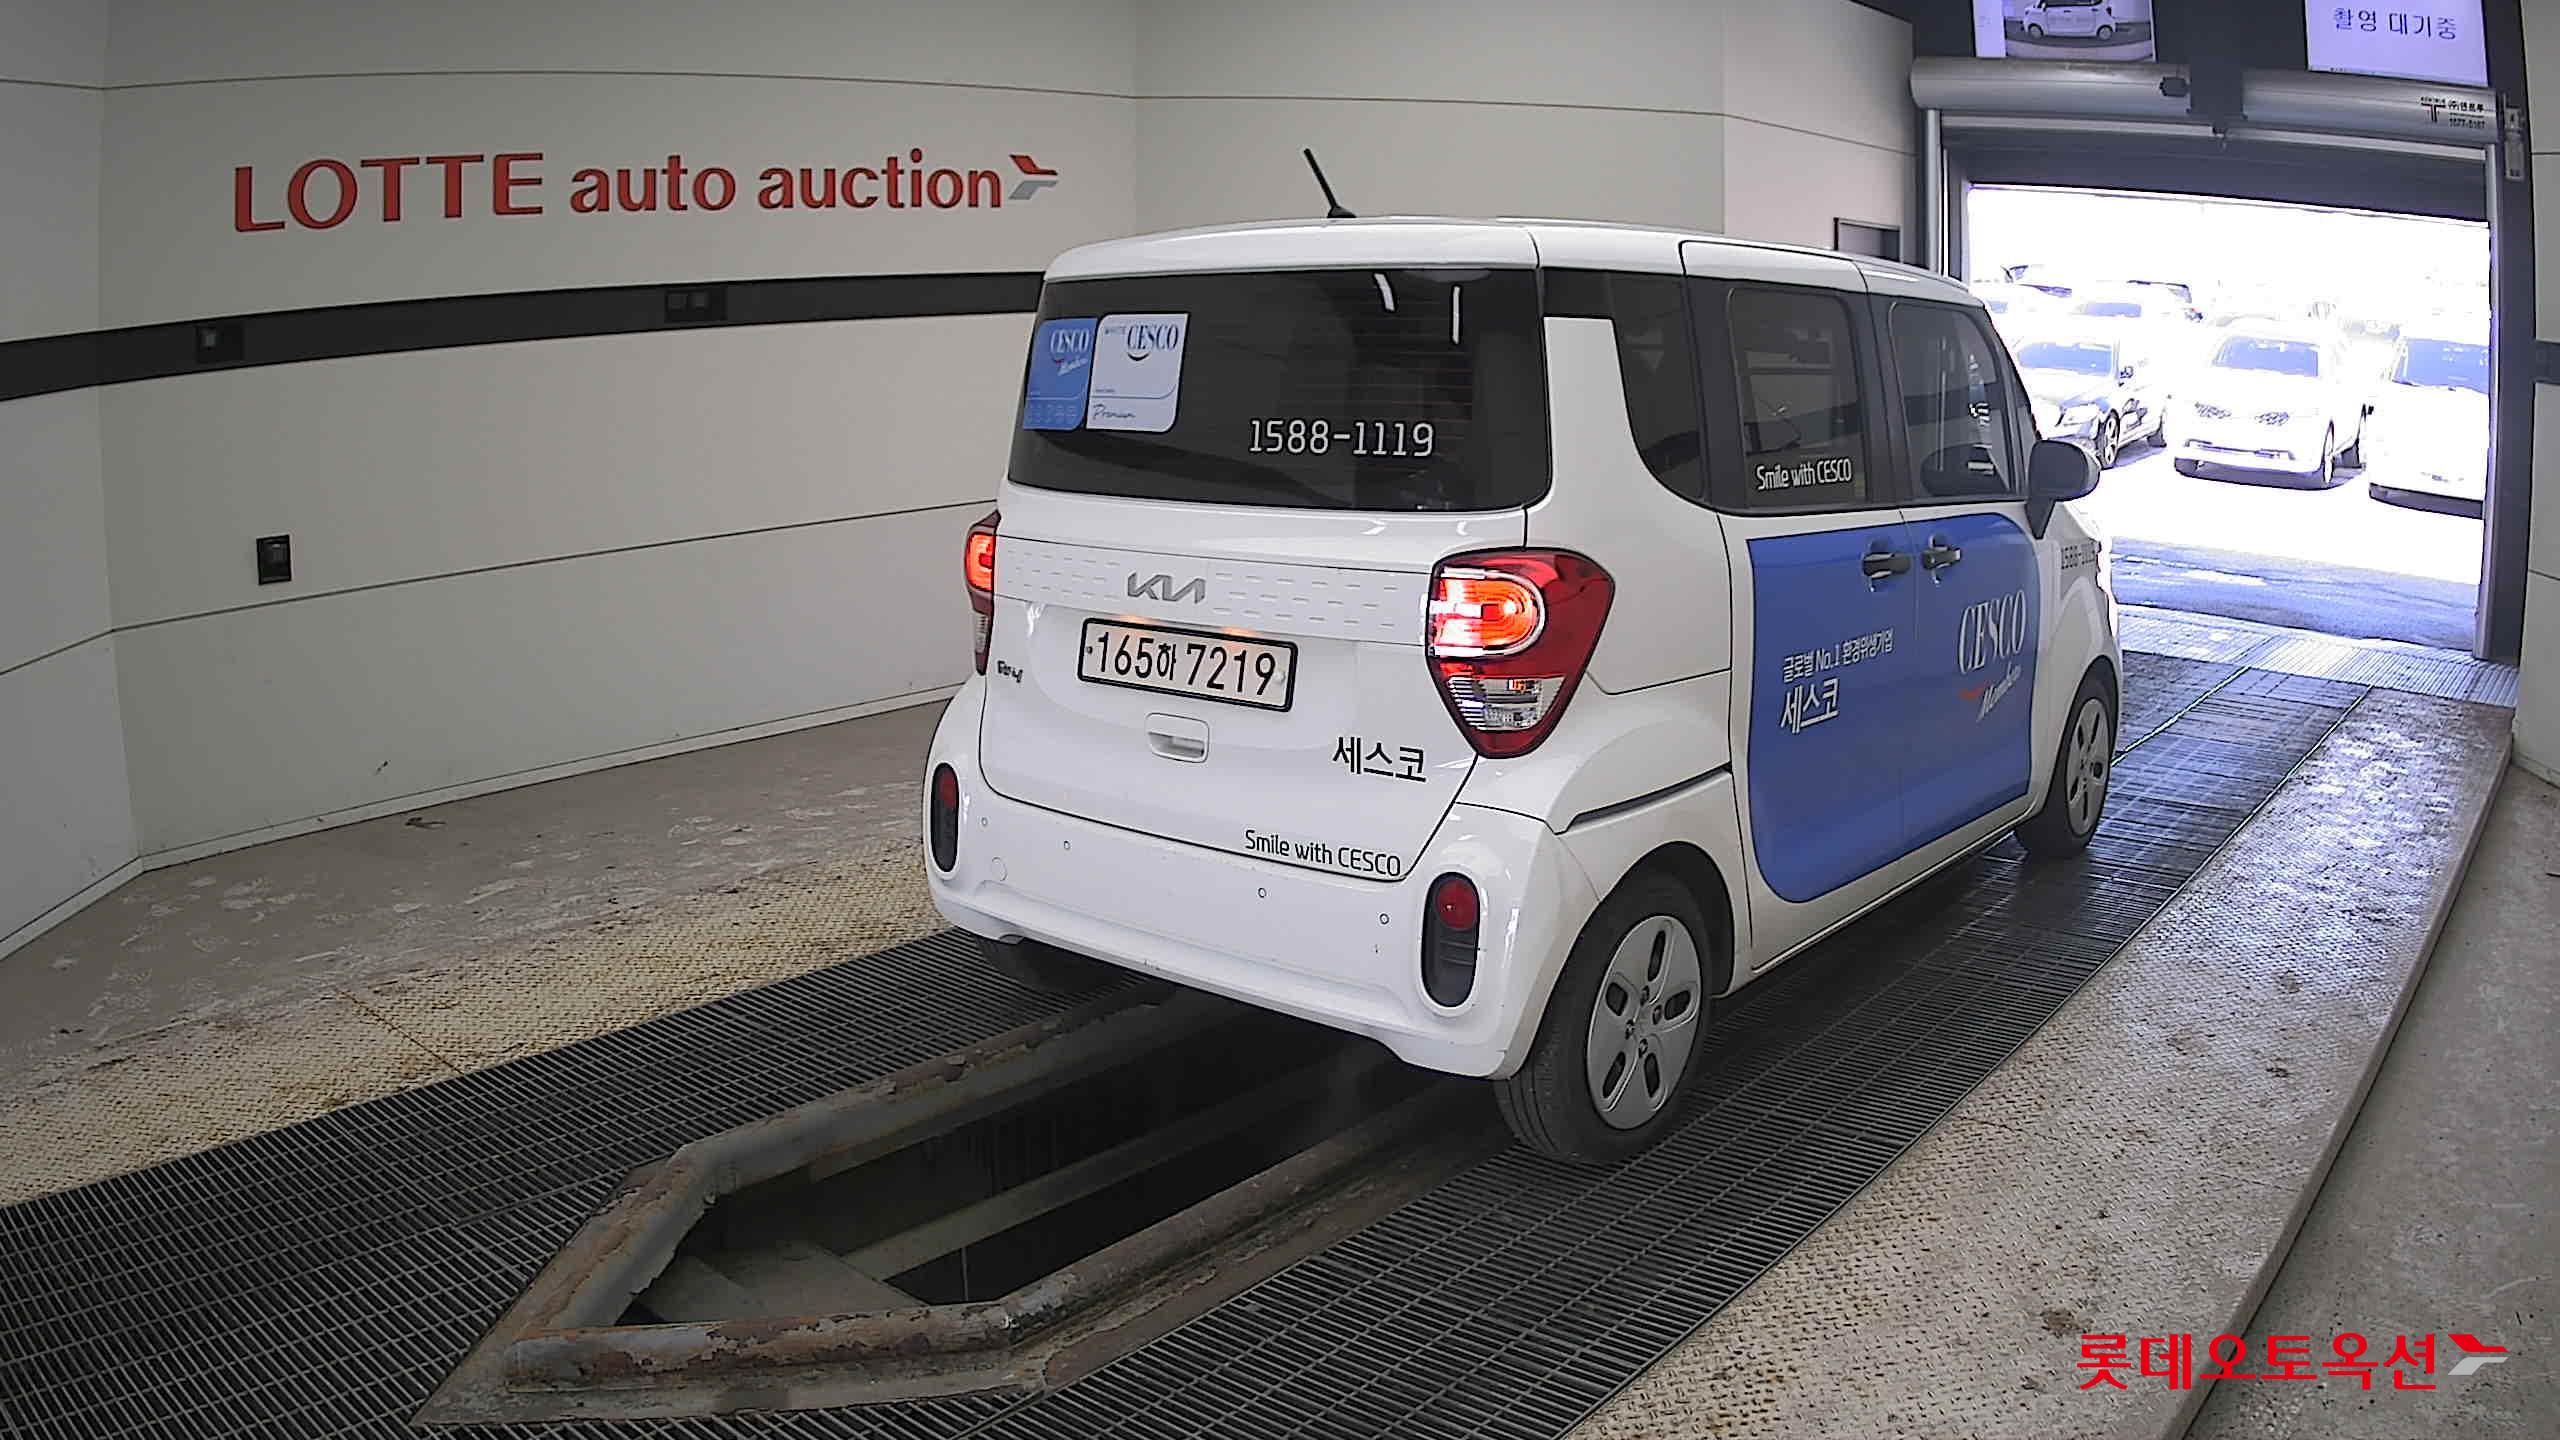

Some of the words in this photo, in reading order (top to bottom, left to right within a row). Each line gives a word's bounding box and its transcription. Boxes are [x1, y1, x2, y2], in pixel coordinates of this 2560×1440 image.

[2389, 13, 2457, 40] 대기중
[234, 152, 544, 233] LOTTE
[570, 154, 736, 213] auto
[759, 148, 1002, 210] auction
[1050, 328, 1090, 353] CESCO
[1127, 323, 1179, 351] CESCO
[1249, 419, 1435, 457] 1588-1119
[1757, 464, 1789, 490] Smile
[1791, 461, 1816, 487] with
[1817, 458, 1852, 483] CESCO
[1959, 589, 2026, 674] CESCO
[1096, 631, 1177, 682] 165하
[1185, 643, 1277, 696] 7219
[1783, 650, 1814, 683] 글로벌
[1815, 643, 1840, 672] No.1
[1780, 678, 1839, 734] 세스코
[1332, 735, 1428, 783] 세스코
[1244, 828, 1290, 859] Smile
[1295, 840, 1333, 866] with
[1337, 846, 1402, 878] CESCO
